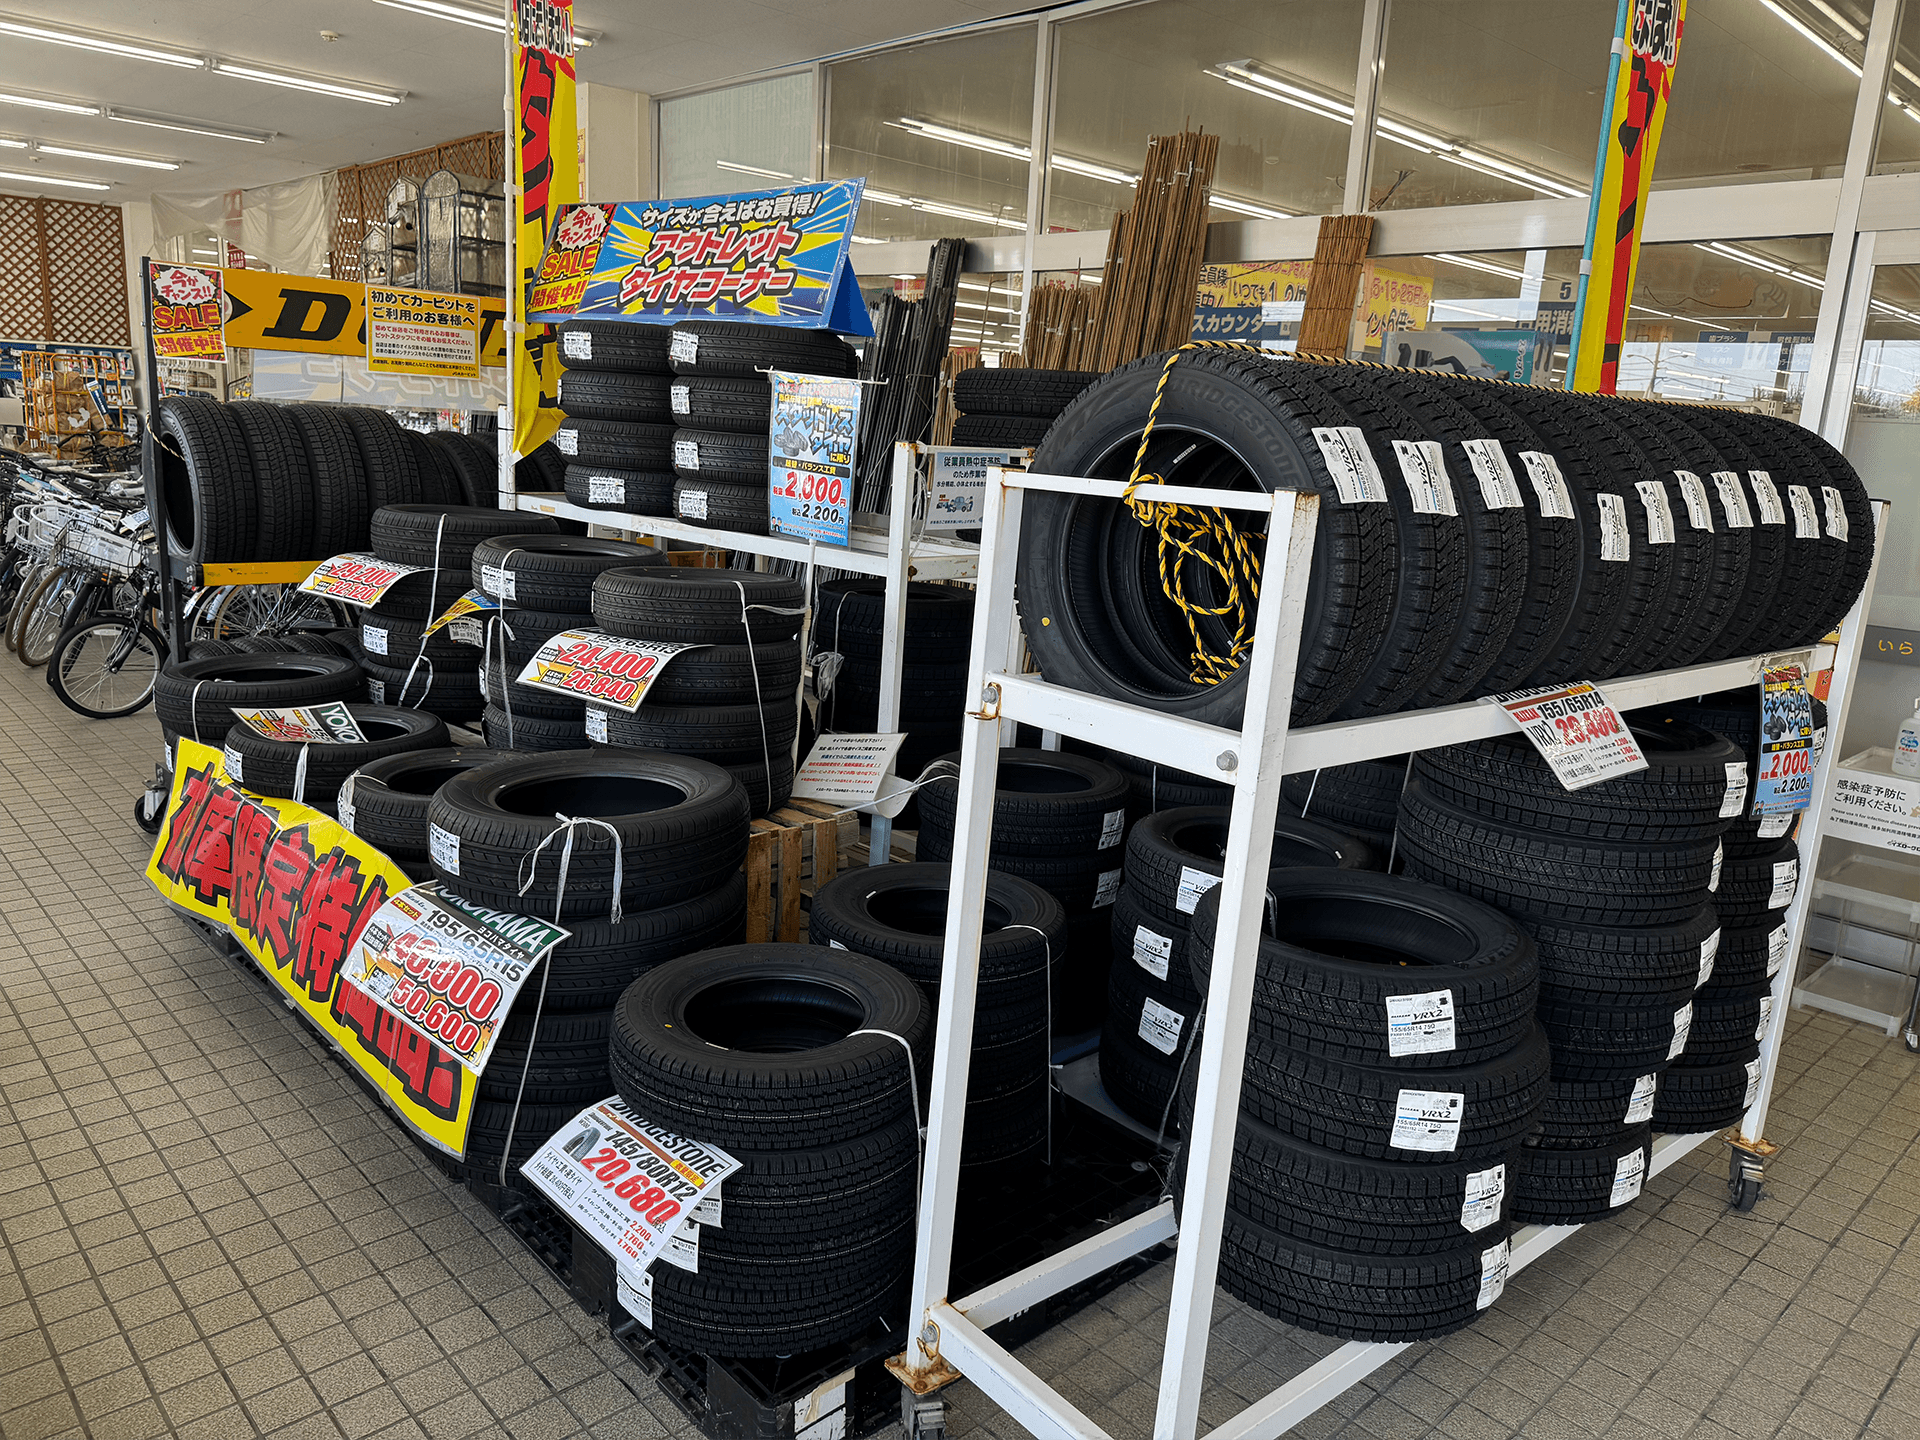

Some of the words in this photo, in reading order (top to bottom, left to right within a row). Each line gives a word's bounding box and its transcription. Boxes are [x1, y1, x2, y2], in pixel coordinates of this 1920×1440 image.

[572, 212, 596, 229] 今が
[642, 192, 823, 229] サイズが合えばお買得!
[645, 220, 803, 267] アウトレット
[542, 244, 598, 280] SALE
[170, 270, 199, 288] 今が
[617, 262, 799, 306] タイヤコーナー
[1559, 282, 1572, 300] 5
[153, 302, 221, 331] SALE
[371, 290, 476, 314] 初めてカーピットを
[372, 306, 476, 327] ご利用のお客様へ
[775, 403, 854, 434] スタッドレス
[809, 430, 853, 455] タイヤ
[1536, 691, 1605, 720] 155/65R14
[1834, 791, 1907, 816] ご利用ください。
[1836, 779, 1907, 801] 感染症予防に
[426, 907, 526, 983] 195/65R15
[477, 925, 526, 960] ヨコハマタイヤ
[1412, 1009, 1443, 1021] VRX2
[1421, 1109, 1452, 1119] VRX2
[604, 1128, 699, 1205] 145/80R12
[579, 1146, 682, 1225] 20,680
